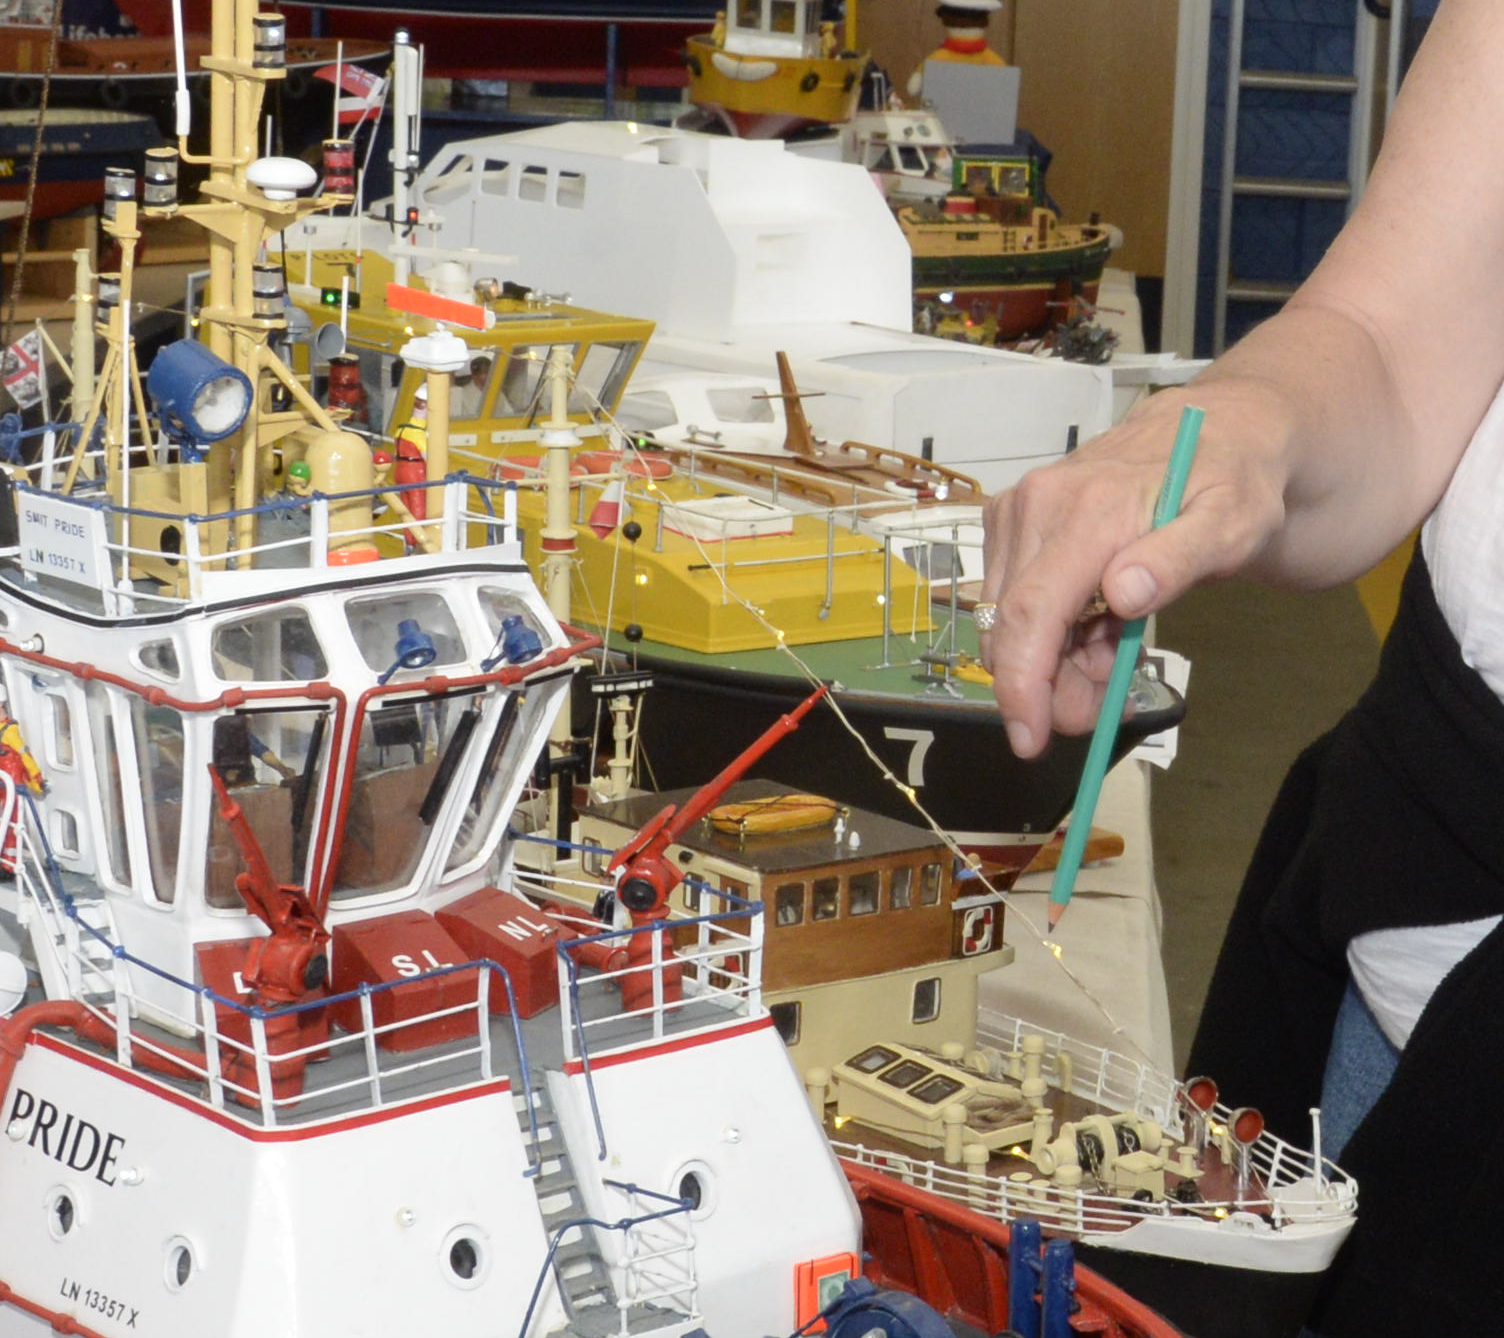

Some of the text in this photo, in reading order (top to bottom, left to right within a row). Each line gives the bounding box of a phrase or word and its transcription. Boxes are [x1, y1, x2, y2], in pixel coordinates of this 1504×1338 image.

[289, 252, 364, 261] PLOTS
[54, 518, 85, 539] PRIDE
[29, 548, 44, 563] LN
[884, 727, 935, 787] 7
[5, 1088, 125, 1187] PRIDE
[59, 1277, 139, 1329] LN 13357 X
